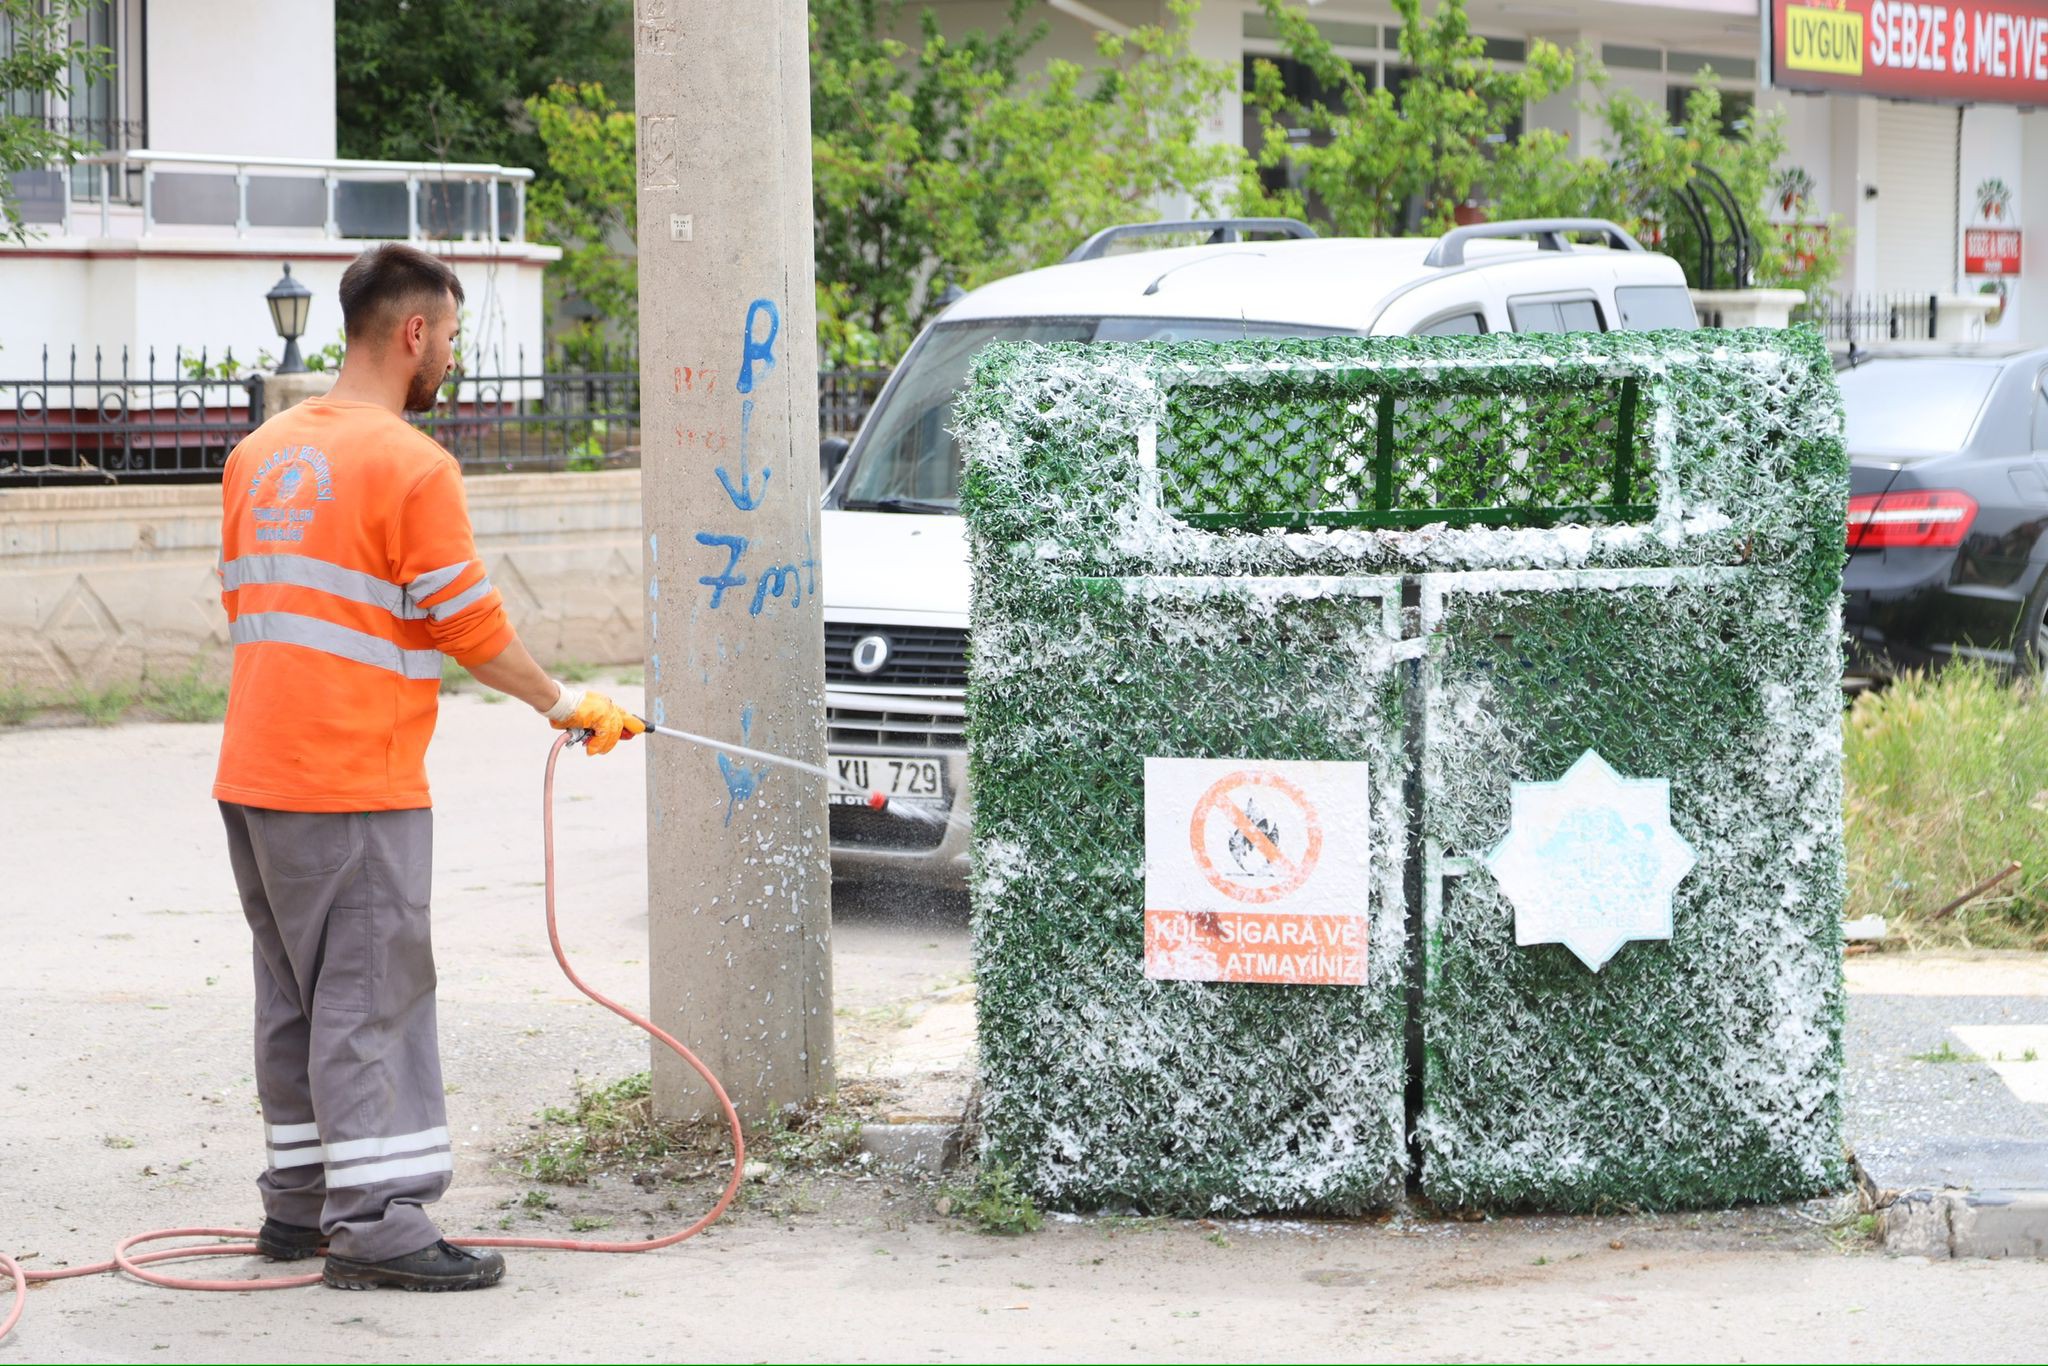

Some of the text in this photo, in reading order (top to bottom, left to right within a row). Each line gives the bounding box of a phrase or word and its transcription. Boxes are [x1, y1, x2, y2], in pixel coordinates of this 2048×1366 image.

[1792, 17, 1858, 62] UYGUN
[1870, 0, 2048, 80] SEBZE & MEYVE
[888, 761, 937, 794] 729
[1324, 920, 1361, 947] VE
